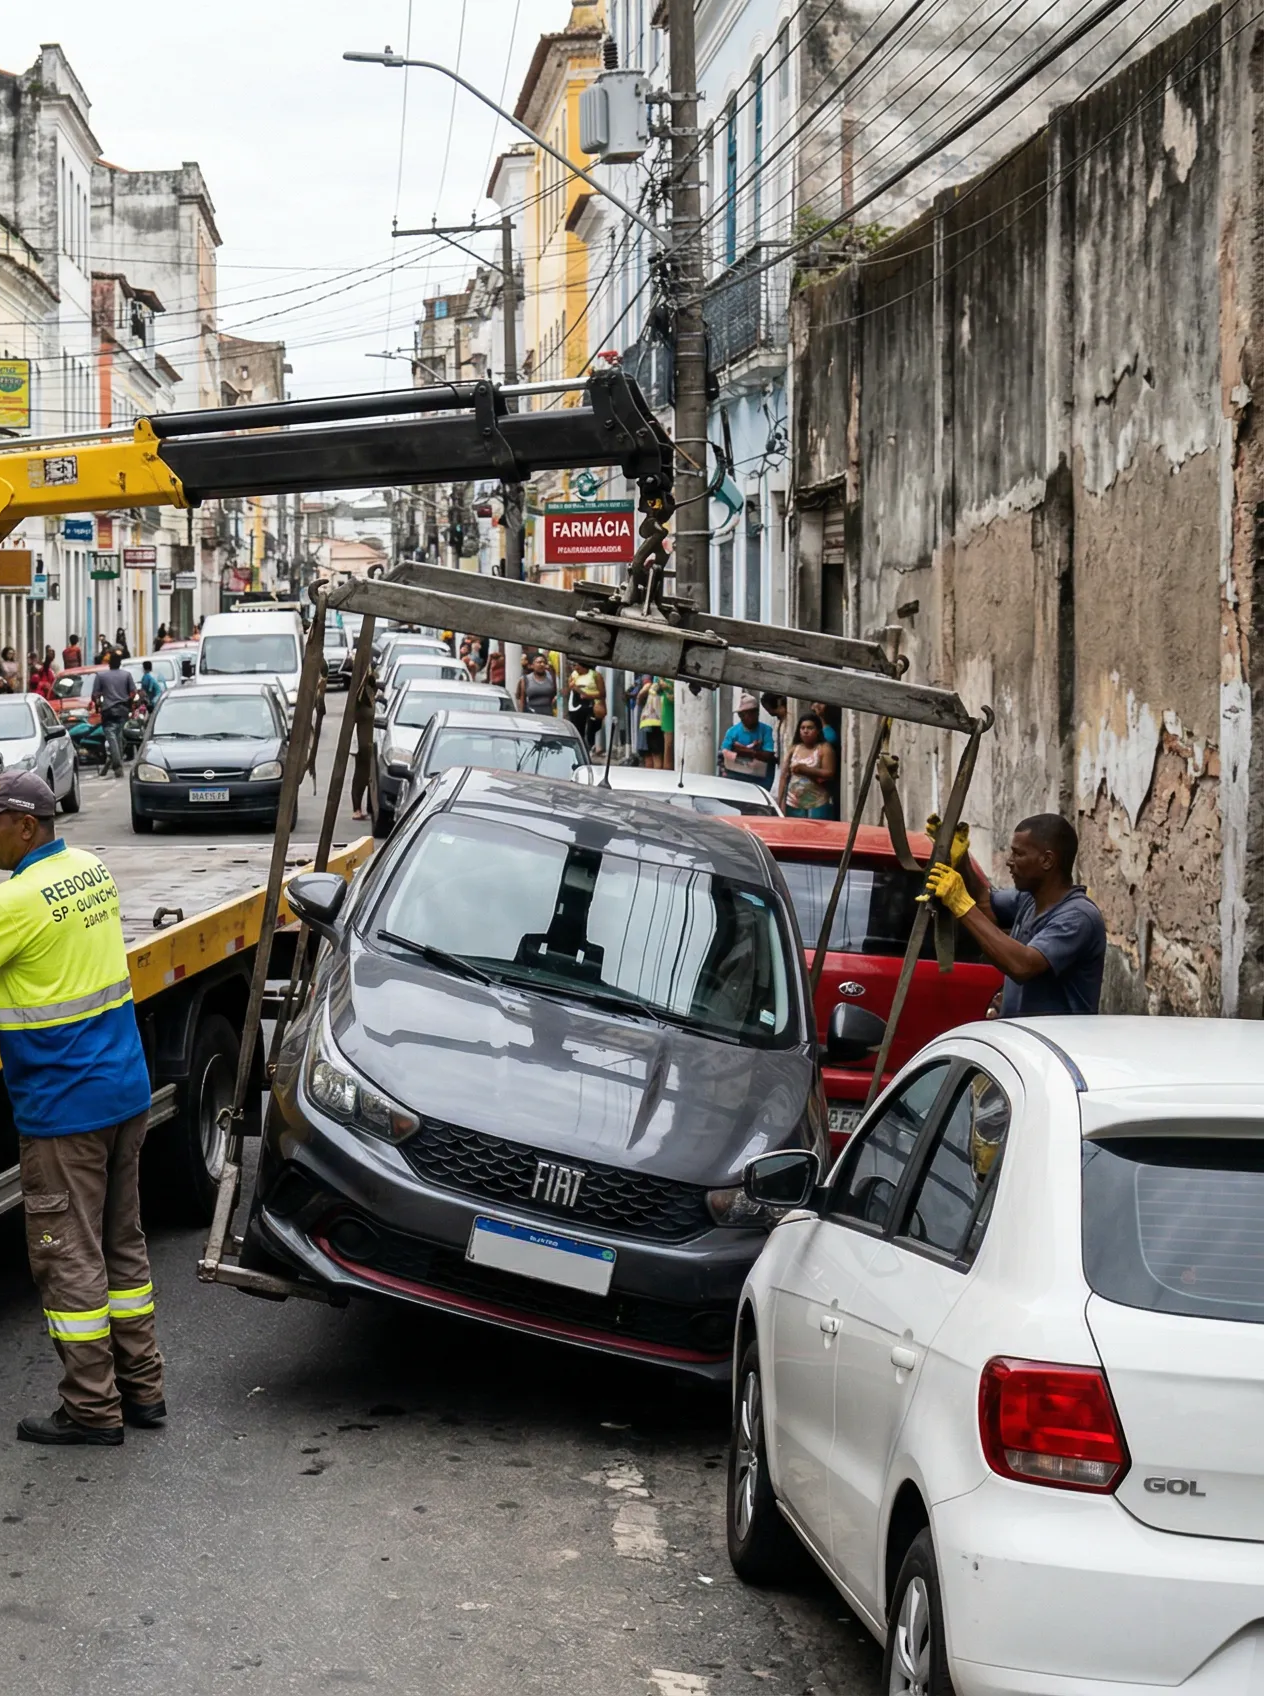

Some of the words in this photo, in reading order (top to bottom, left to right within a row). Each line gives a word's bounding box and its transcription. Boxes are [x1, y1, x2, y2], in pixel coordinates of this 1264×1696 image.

[552, 516, 631, 538] FARMÁCIA
[40, 864, 110, 906] REBOQUE
[52, 905, 69, 923] SP
[531, 1161, 586, 1208] FIAT
[1143, 1475, 1207, 1498] GOL
